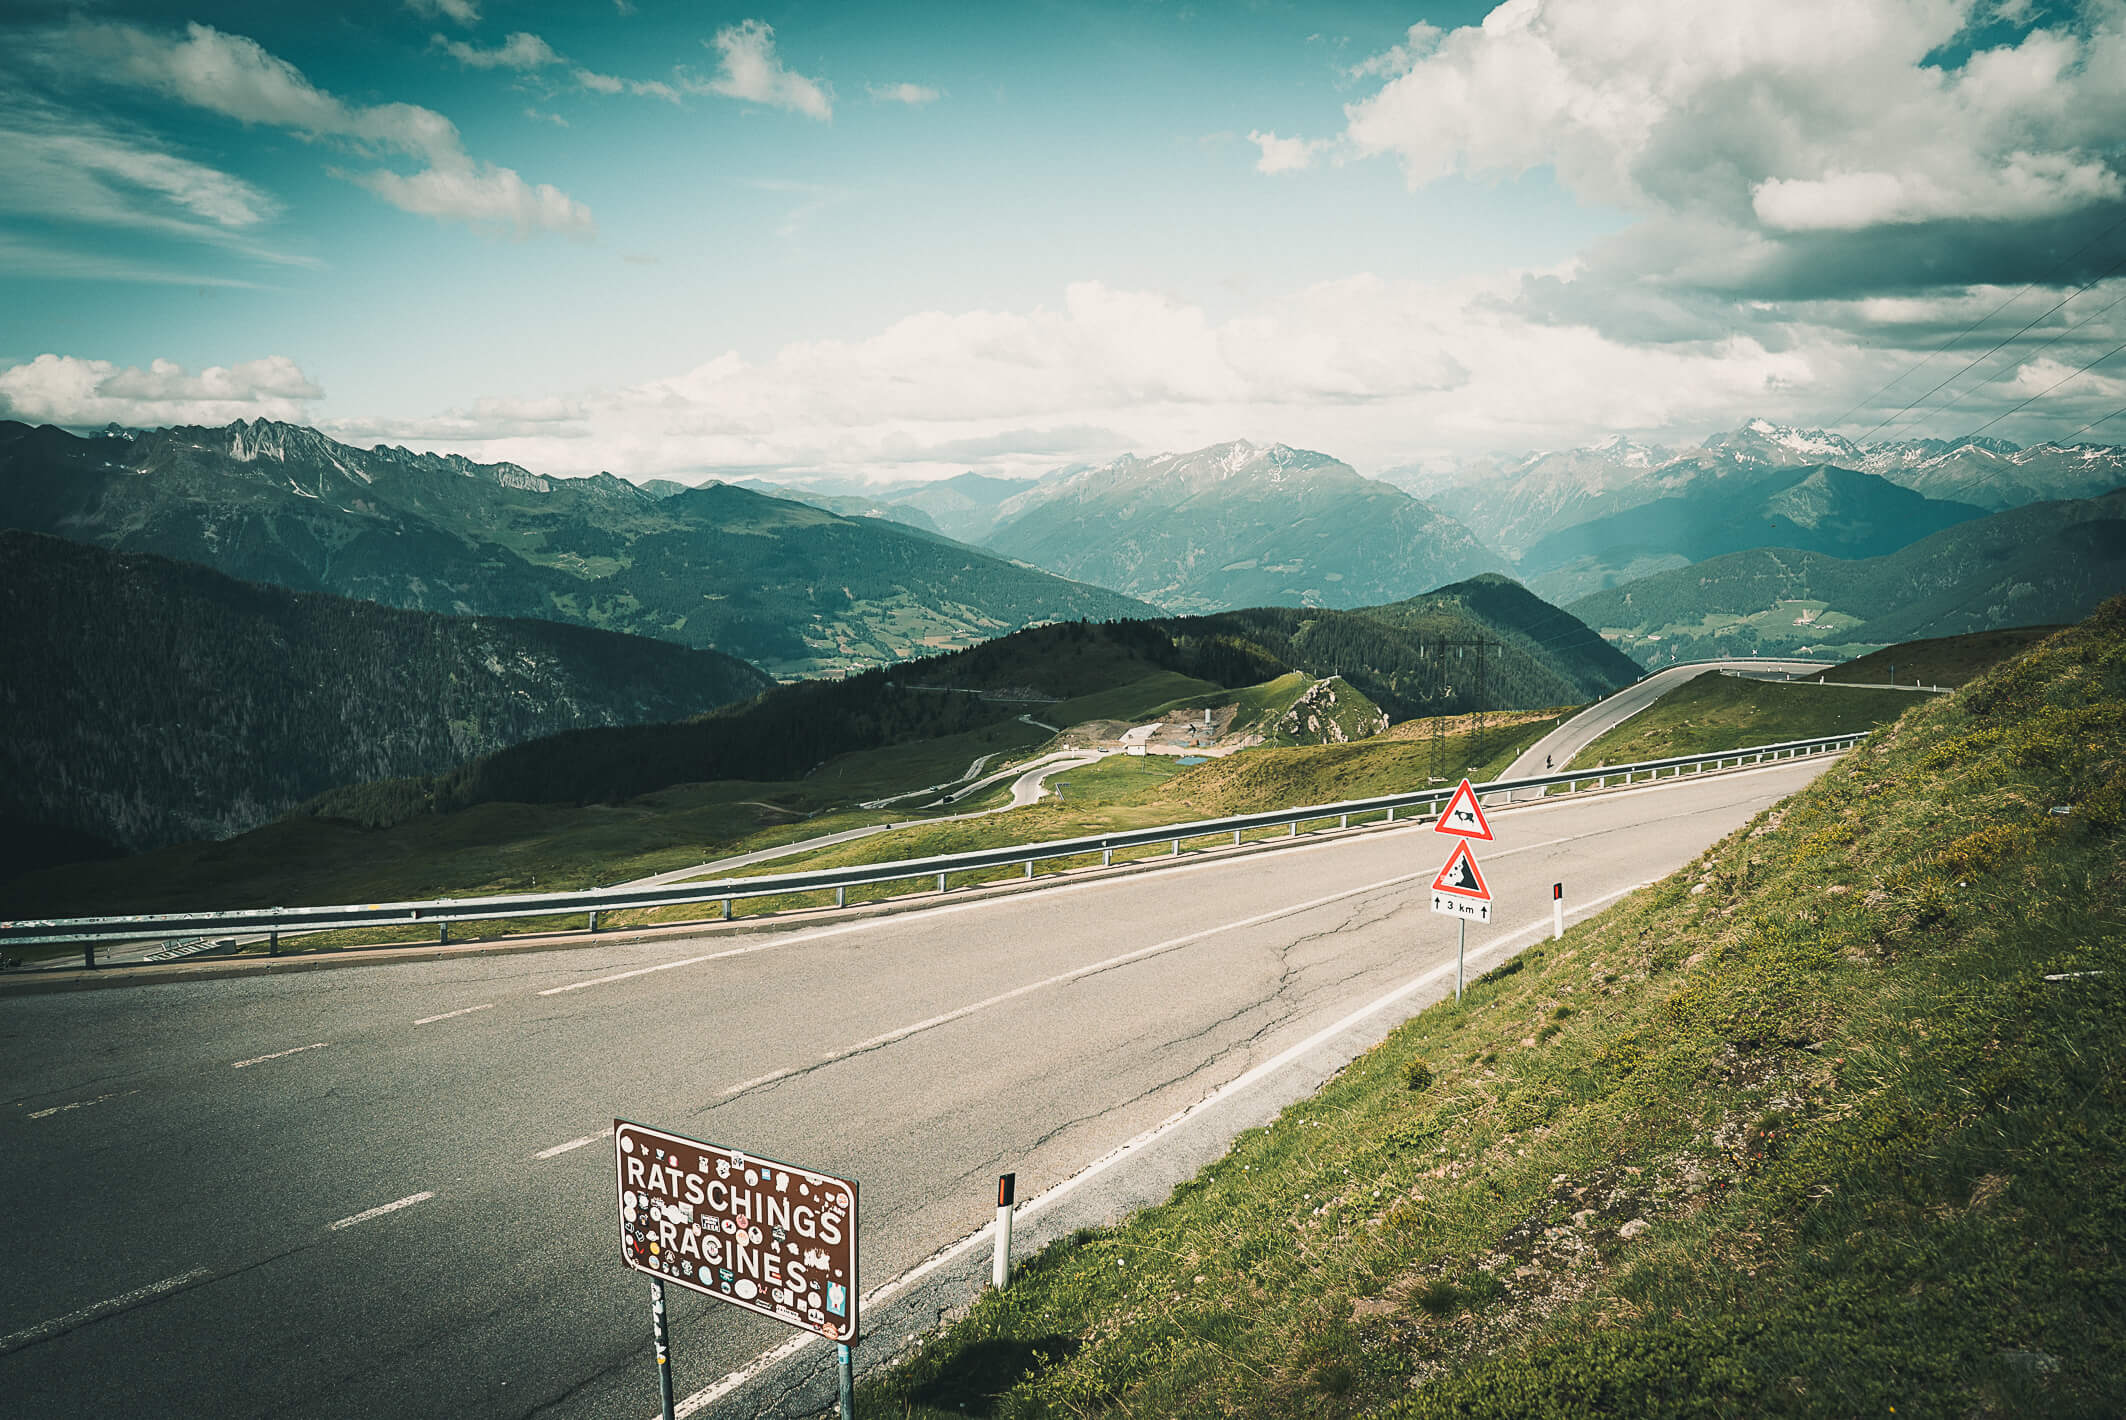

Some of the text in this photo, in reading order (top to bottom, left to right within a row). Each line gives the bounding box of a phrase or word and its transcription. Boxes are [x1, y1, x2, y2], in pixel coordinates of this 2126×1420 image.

[1447, 900, 1474, 914] 3 km
[627, 1156, 842, 1245] RATSCHINGS
[659, 1220, 807, 1293] RACINES
